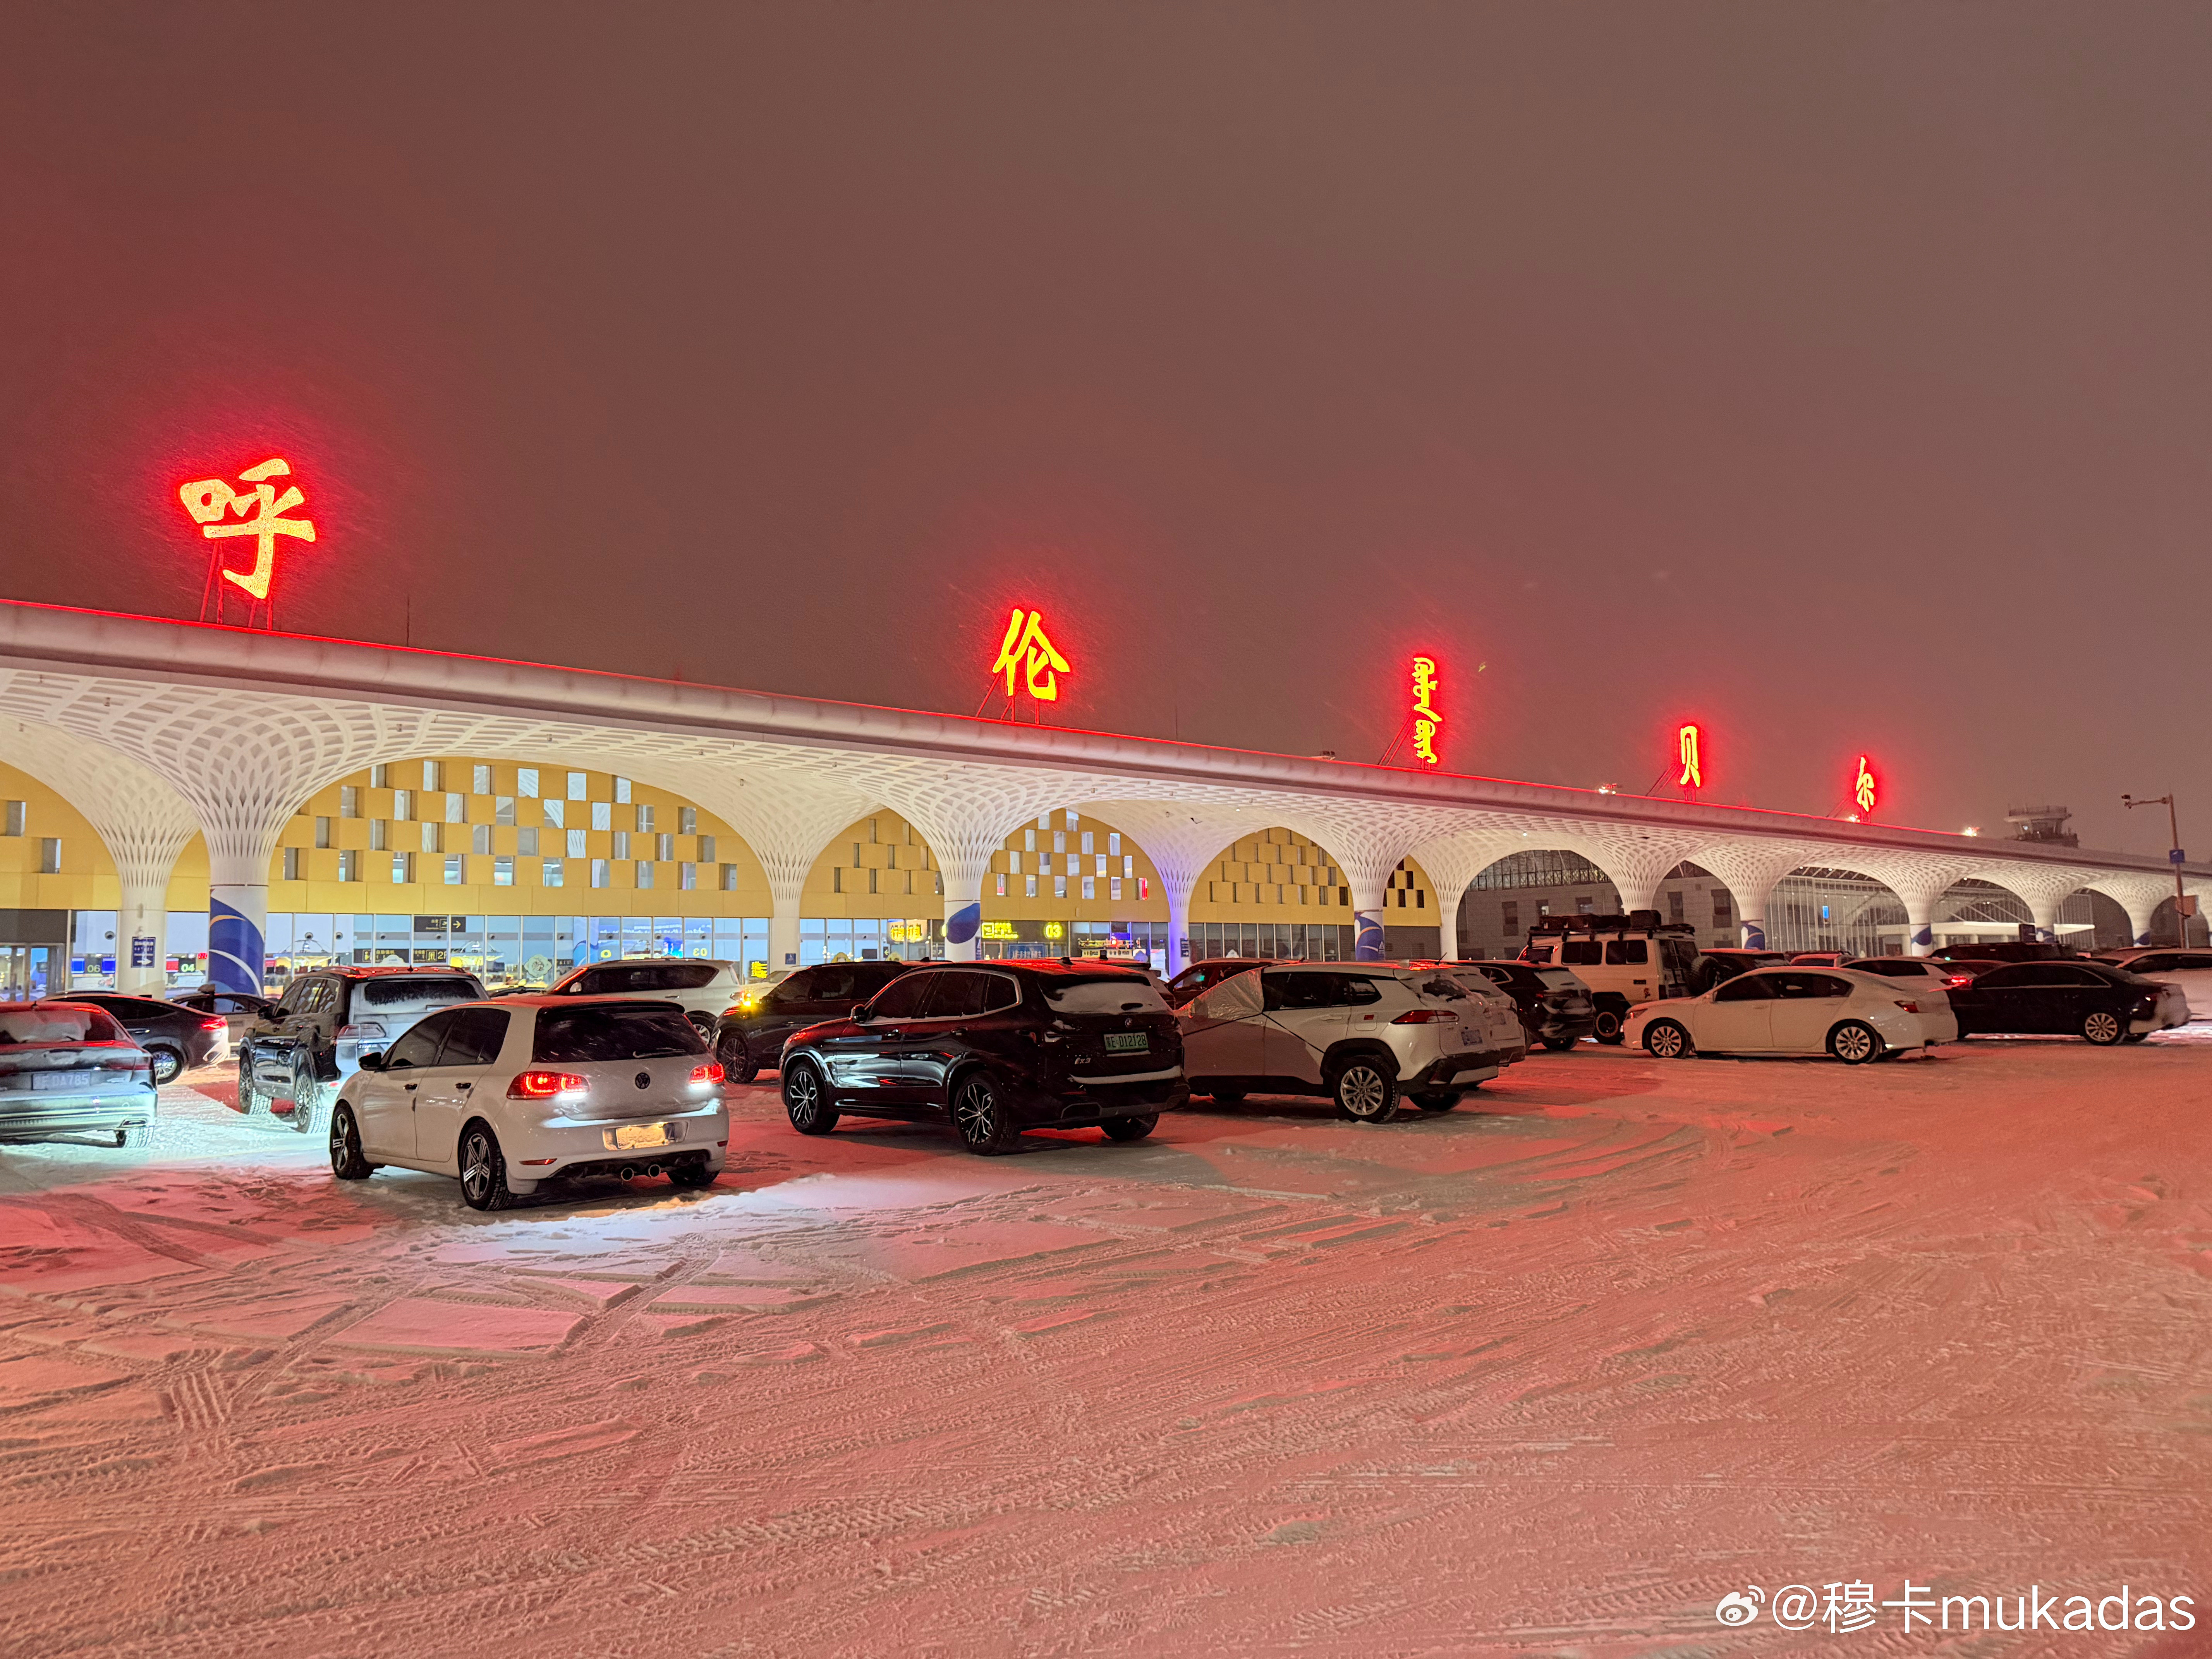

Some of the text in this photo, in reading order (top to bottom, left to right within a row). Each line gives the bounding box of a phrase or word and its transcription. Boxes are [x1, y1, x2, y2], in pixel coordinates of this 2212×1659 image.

[180, 459, 1875, 812] 呼 伦 贝 尔
[1046, 924, 1062, 938] 03
[87, 965, 101, 973] 06
[181, 963, 195, 972] 04
